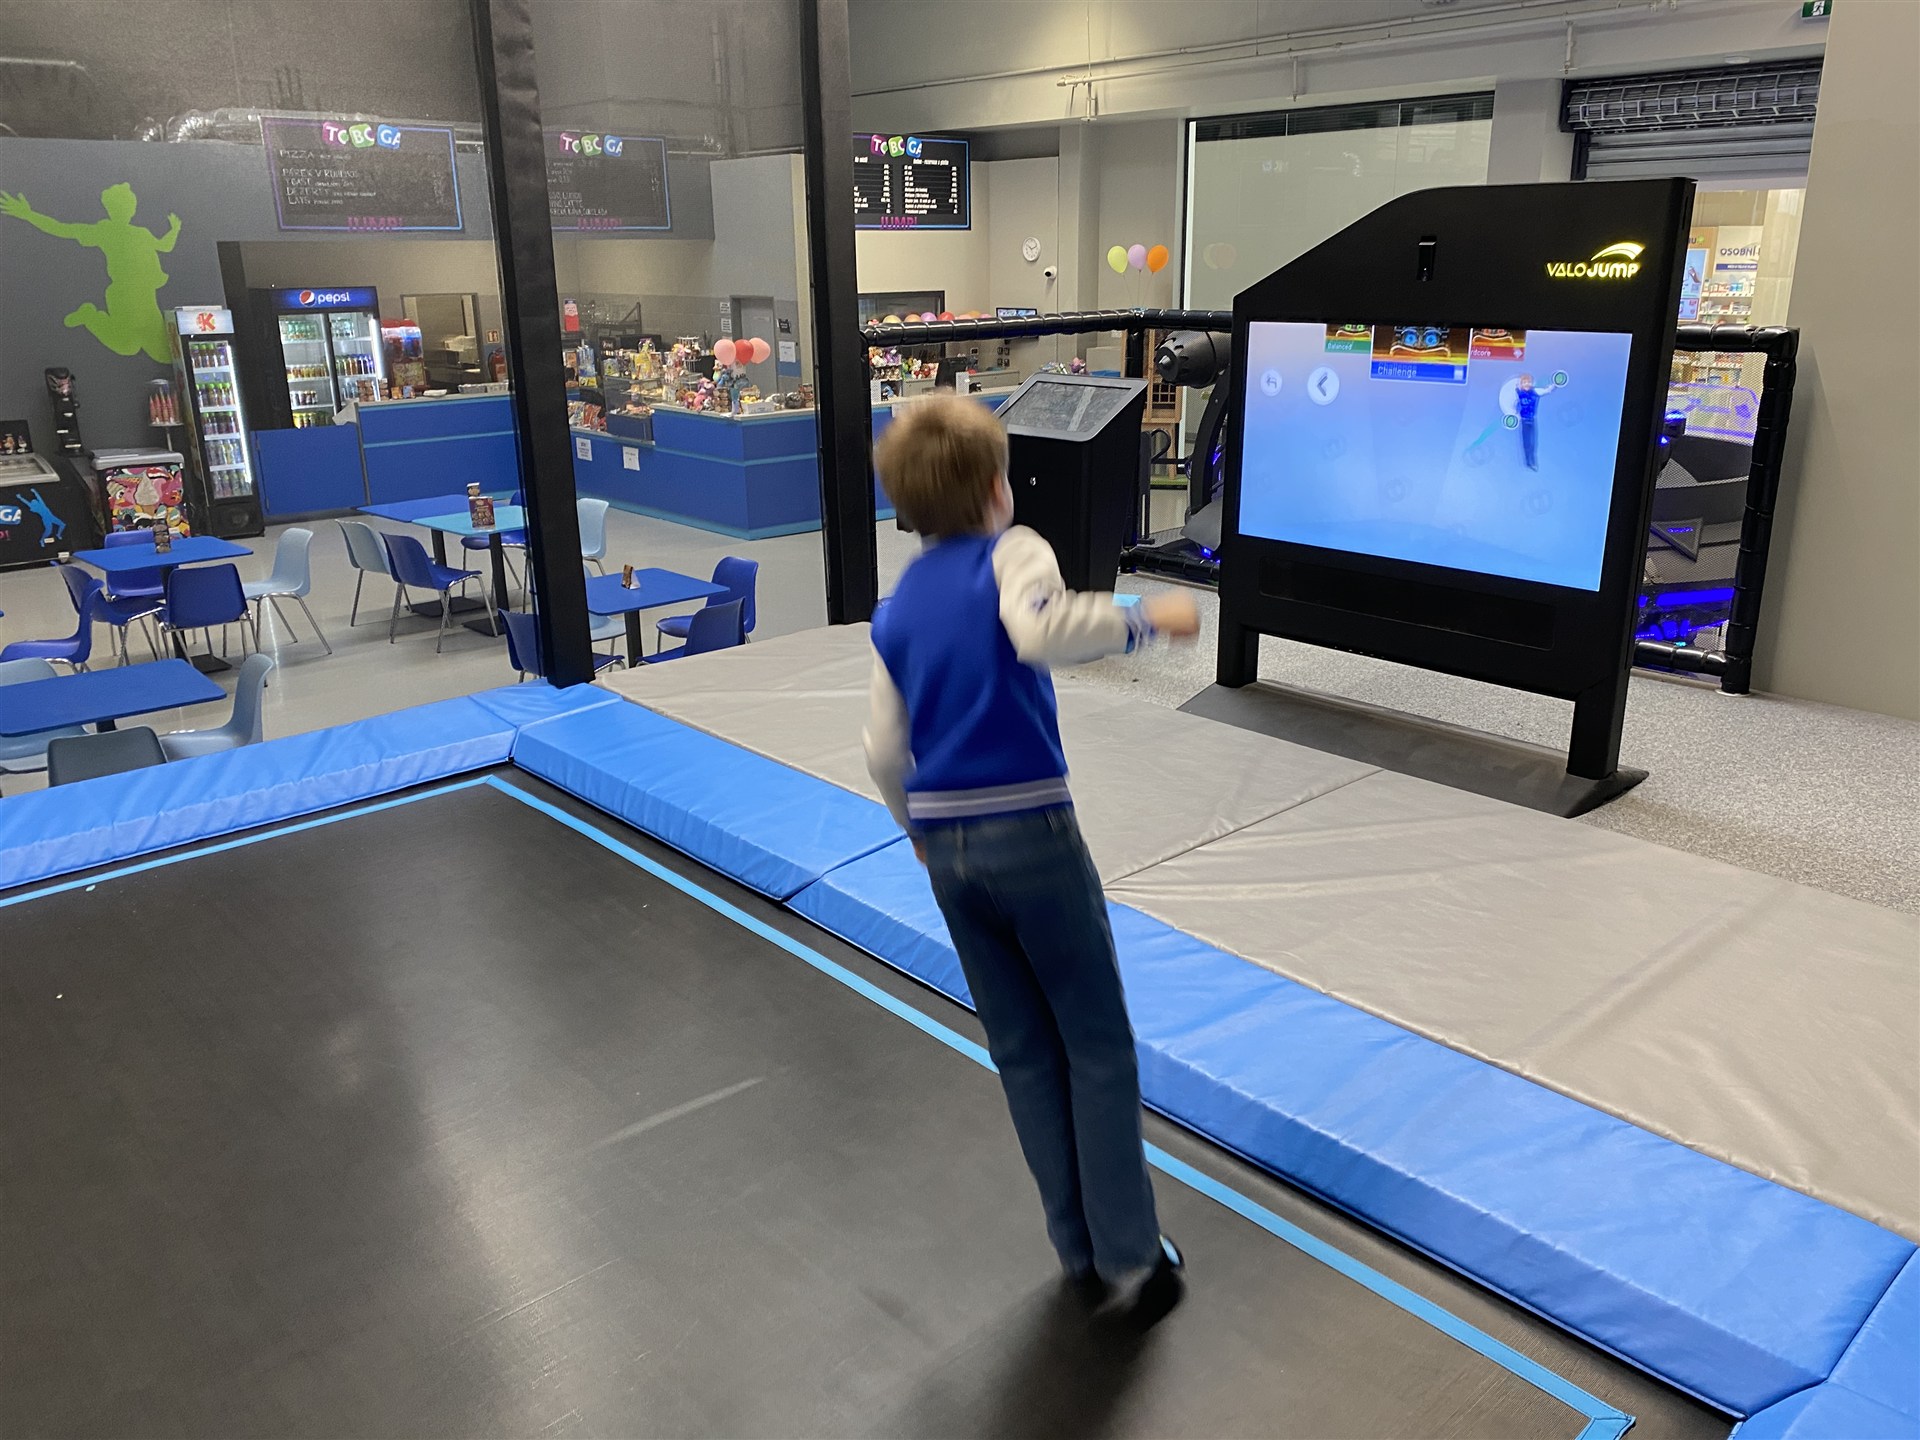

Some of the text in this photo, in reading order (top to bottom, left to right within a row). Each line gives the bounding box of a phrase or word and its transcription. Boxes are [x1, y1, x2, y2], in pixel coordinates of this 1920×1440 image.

[1719, 246, 1756, 258] OSOBNÍ
[317, 292, 350, 305] pepsi
[1377, 365, 1417, 379] Challenge
